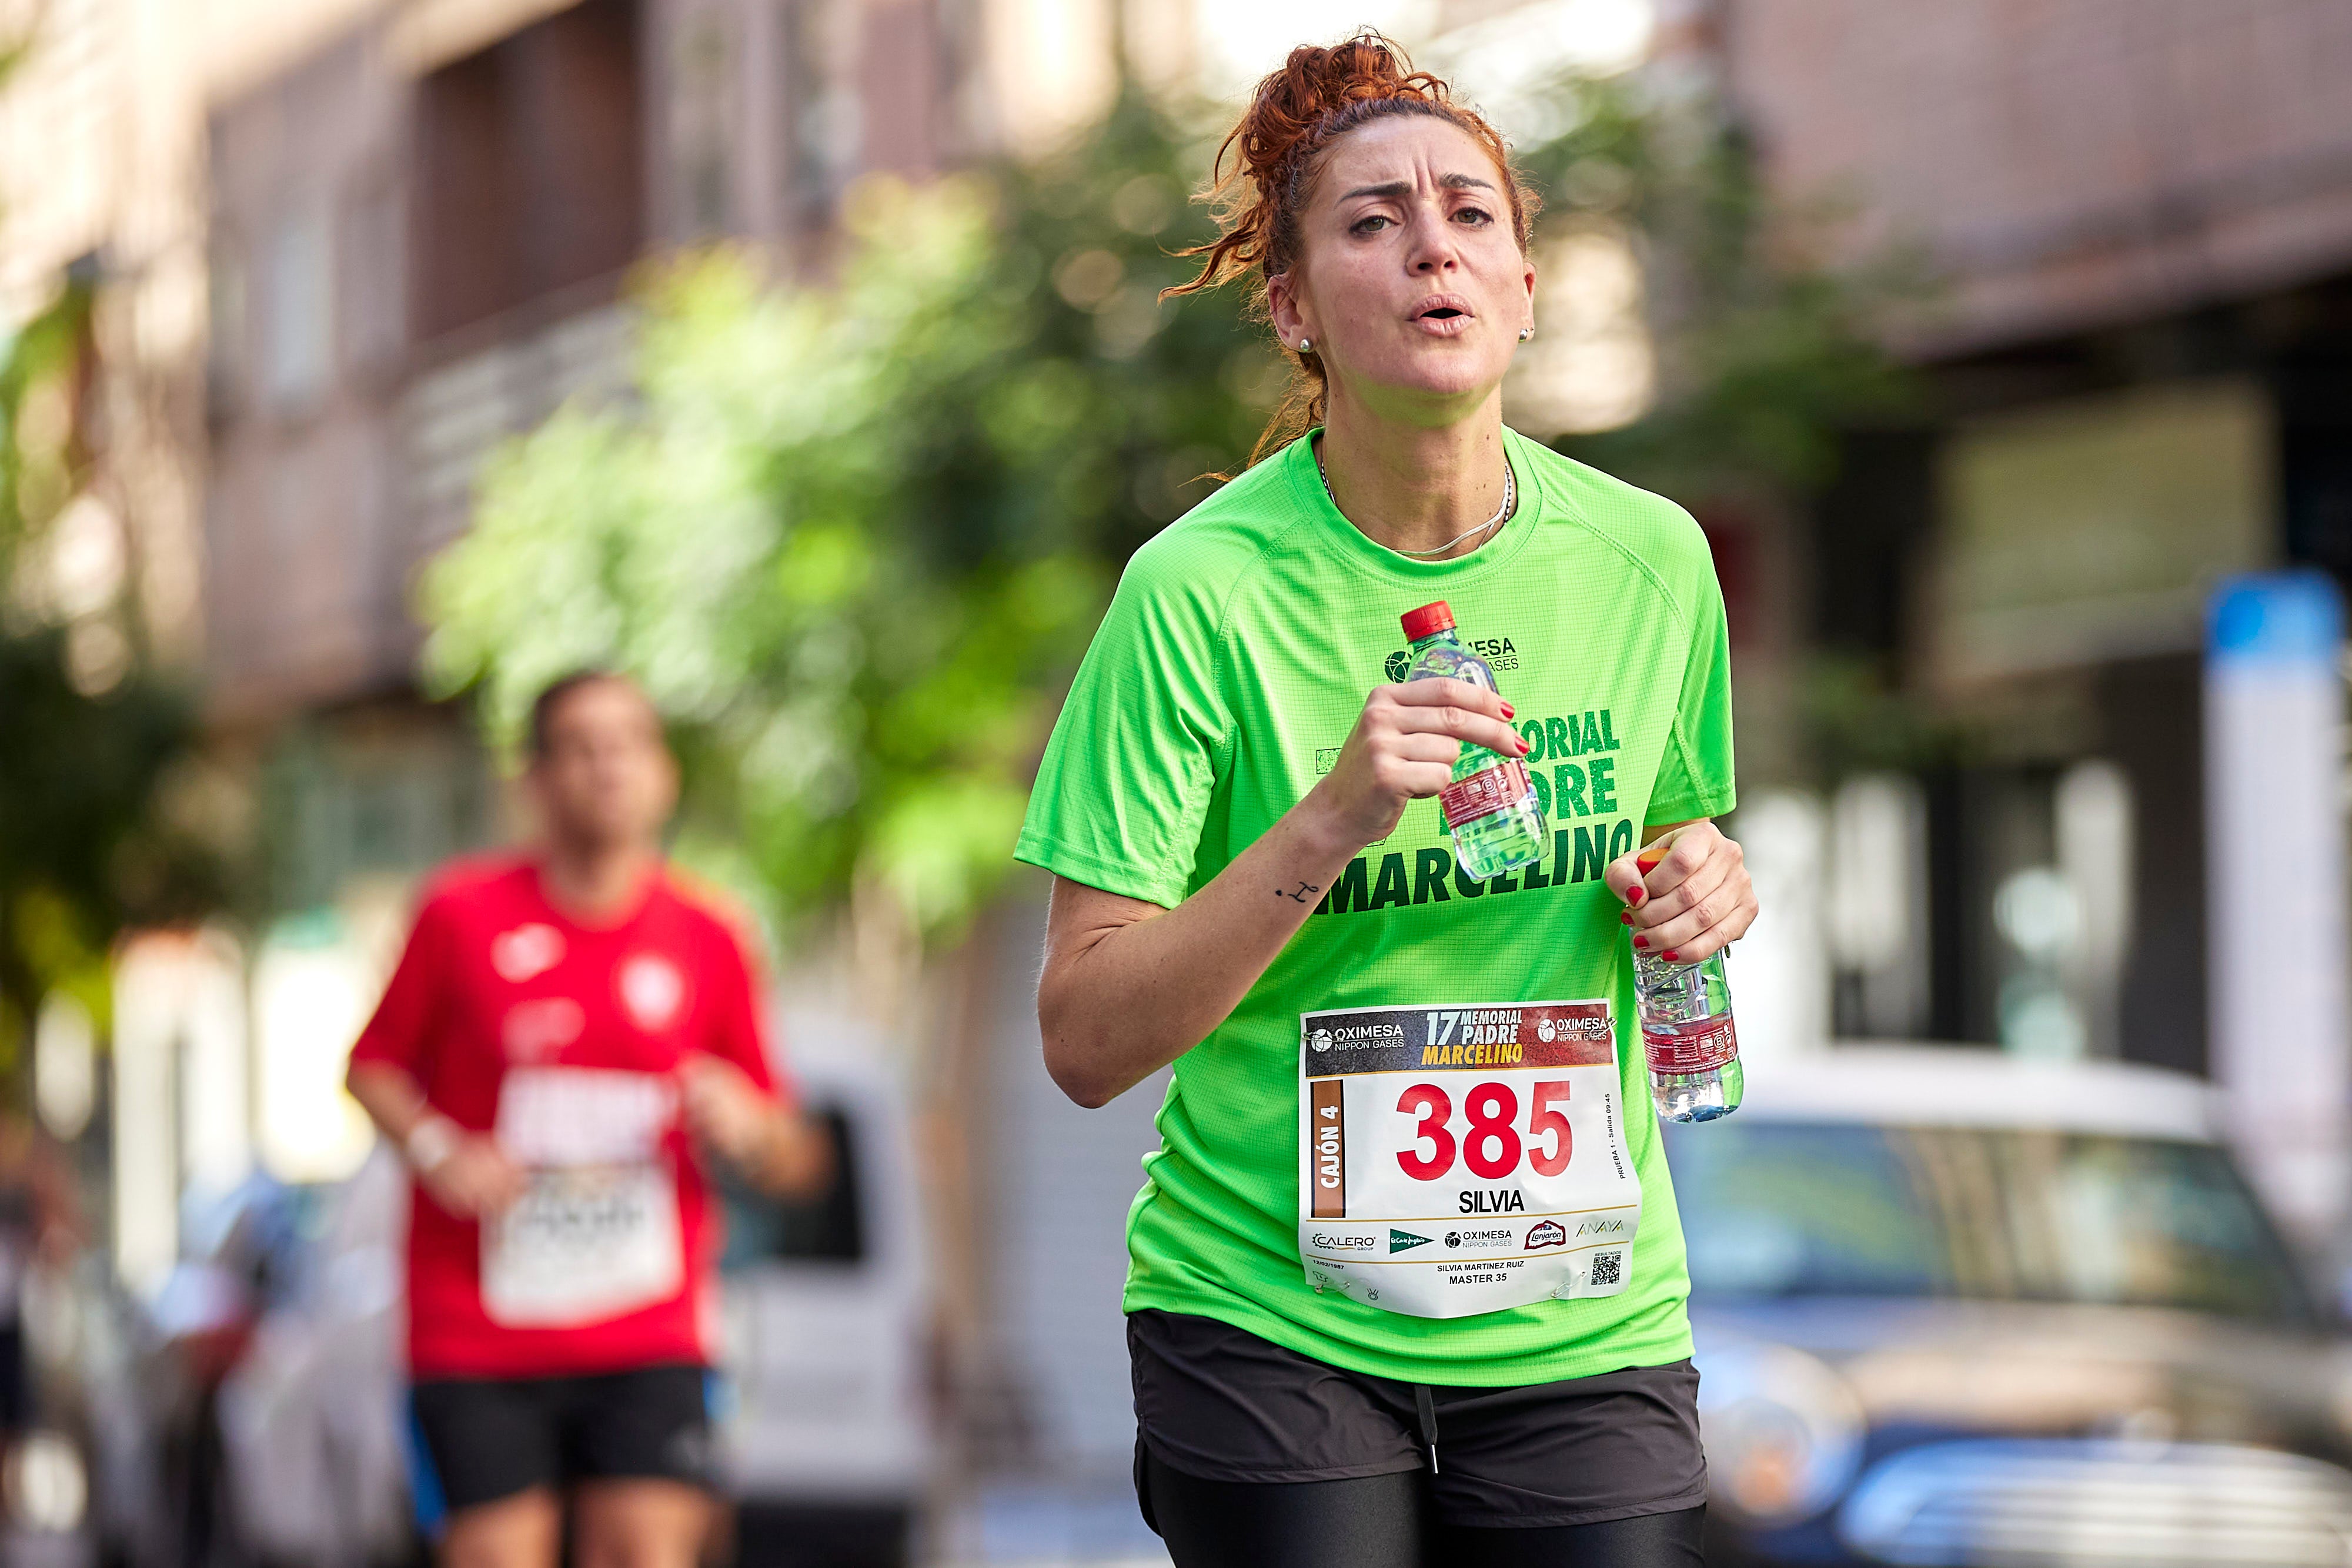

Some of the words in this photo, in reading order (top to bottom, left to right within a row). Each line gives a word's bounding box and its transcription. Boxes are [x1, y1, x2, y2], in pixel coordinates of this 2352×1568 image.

[1489, 658, 1519, 671] SES
[1511, 709, 1620, 763] ORIAL
[1460, 1010, 1522, 1025] MEMORIAL
[1556, 1018, 1607, 1031] OXIMESA
[1334, 1024, 1404, 1039] OXIMESA
[1426, 1011, 1461, 1045] 17
[1461, 1024, 1518, 1045] PADRE
[1335, 1040, 1369, 1051] NIPPON
[1373, 1039, 1404, 1048] GASES
[1557, 1033, 1582, 1042] NIPPON
[1421, 1044, 1522, 1065] MARCELINO
[1321, 1105, 1338, 1119] 4
[1396, 1081, 1573, 1181] 385
[1316, 1126, 1340, 1188] CAJÓN
[1612, 1150, 1626, 1179] PRUEBA
[1459, 1189, 1525, 1213] SILVIA
[1463, 1230, 1512, 1240] OXIMESA
[1576, 1220, 1623, 1237] ANAYA
[1317, 1236, 1374, 1246] CALERO
[1531, 1231, 1561, 1242] Lanjarón
[1449, 1274, 1493, 1285] MASTER
[1496, 1273, 1507, 1282] 35
